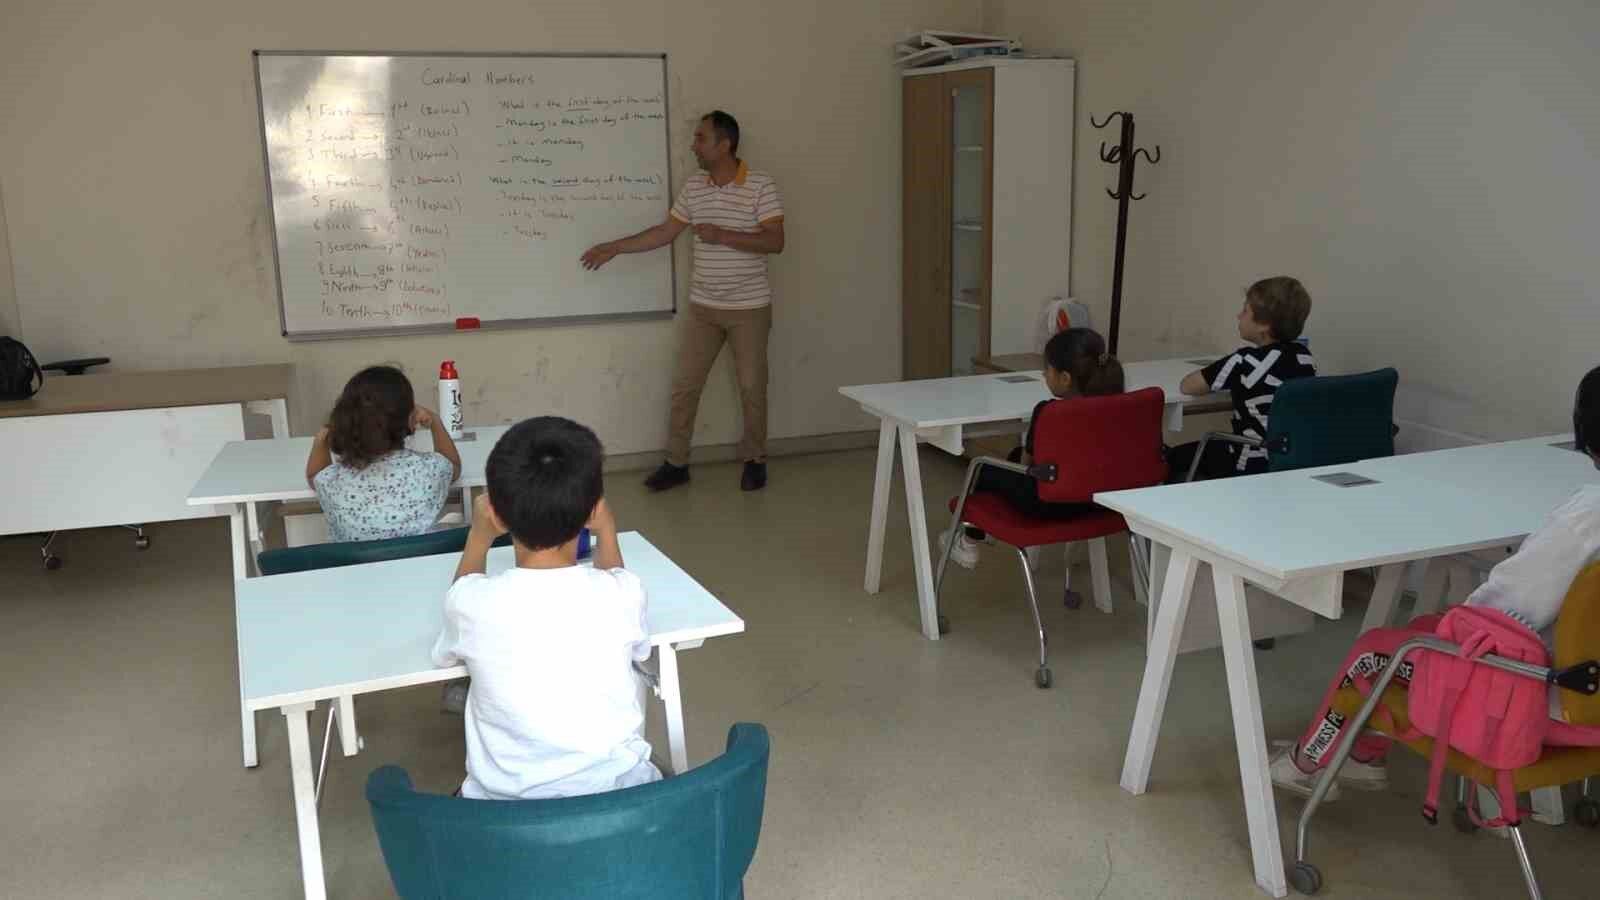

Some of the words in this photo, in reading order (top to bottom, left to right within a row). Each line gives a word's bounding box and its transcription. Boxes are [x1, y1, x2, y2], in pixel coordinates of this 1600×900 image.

[421, 68, 471, 86] Cardinal
[485, 71, 536, 86] Numbers
[505, 117, 547, 132] Monday
[511, 154, 553, 167] Monday
